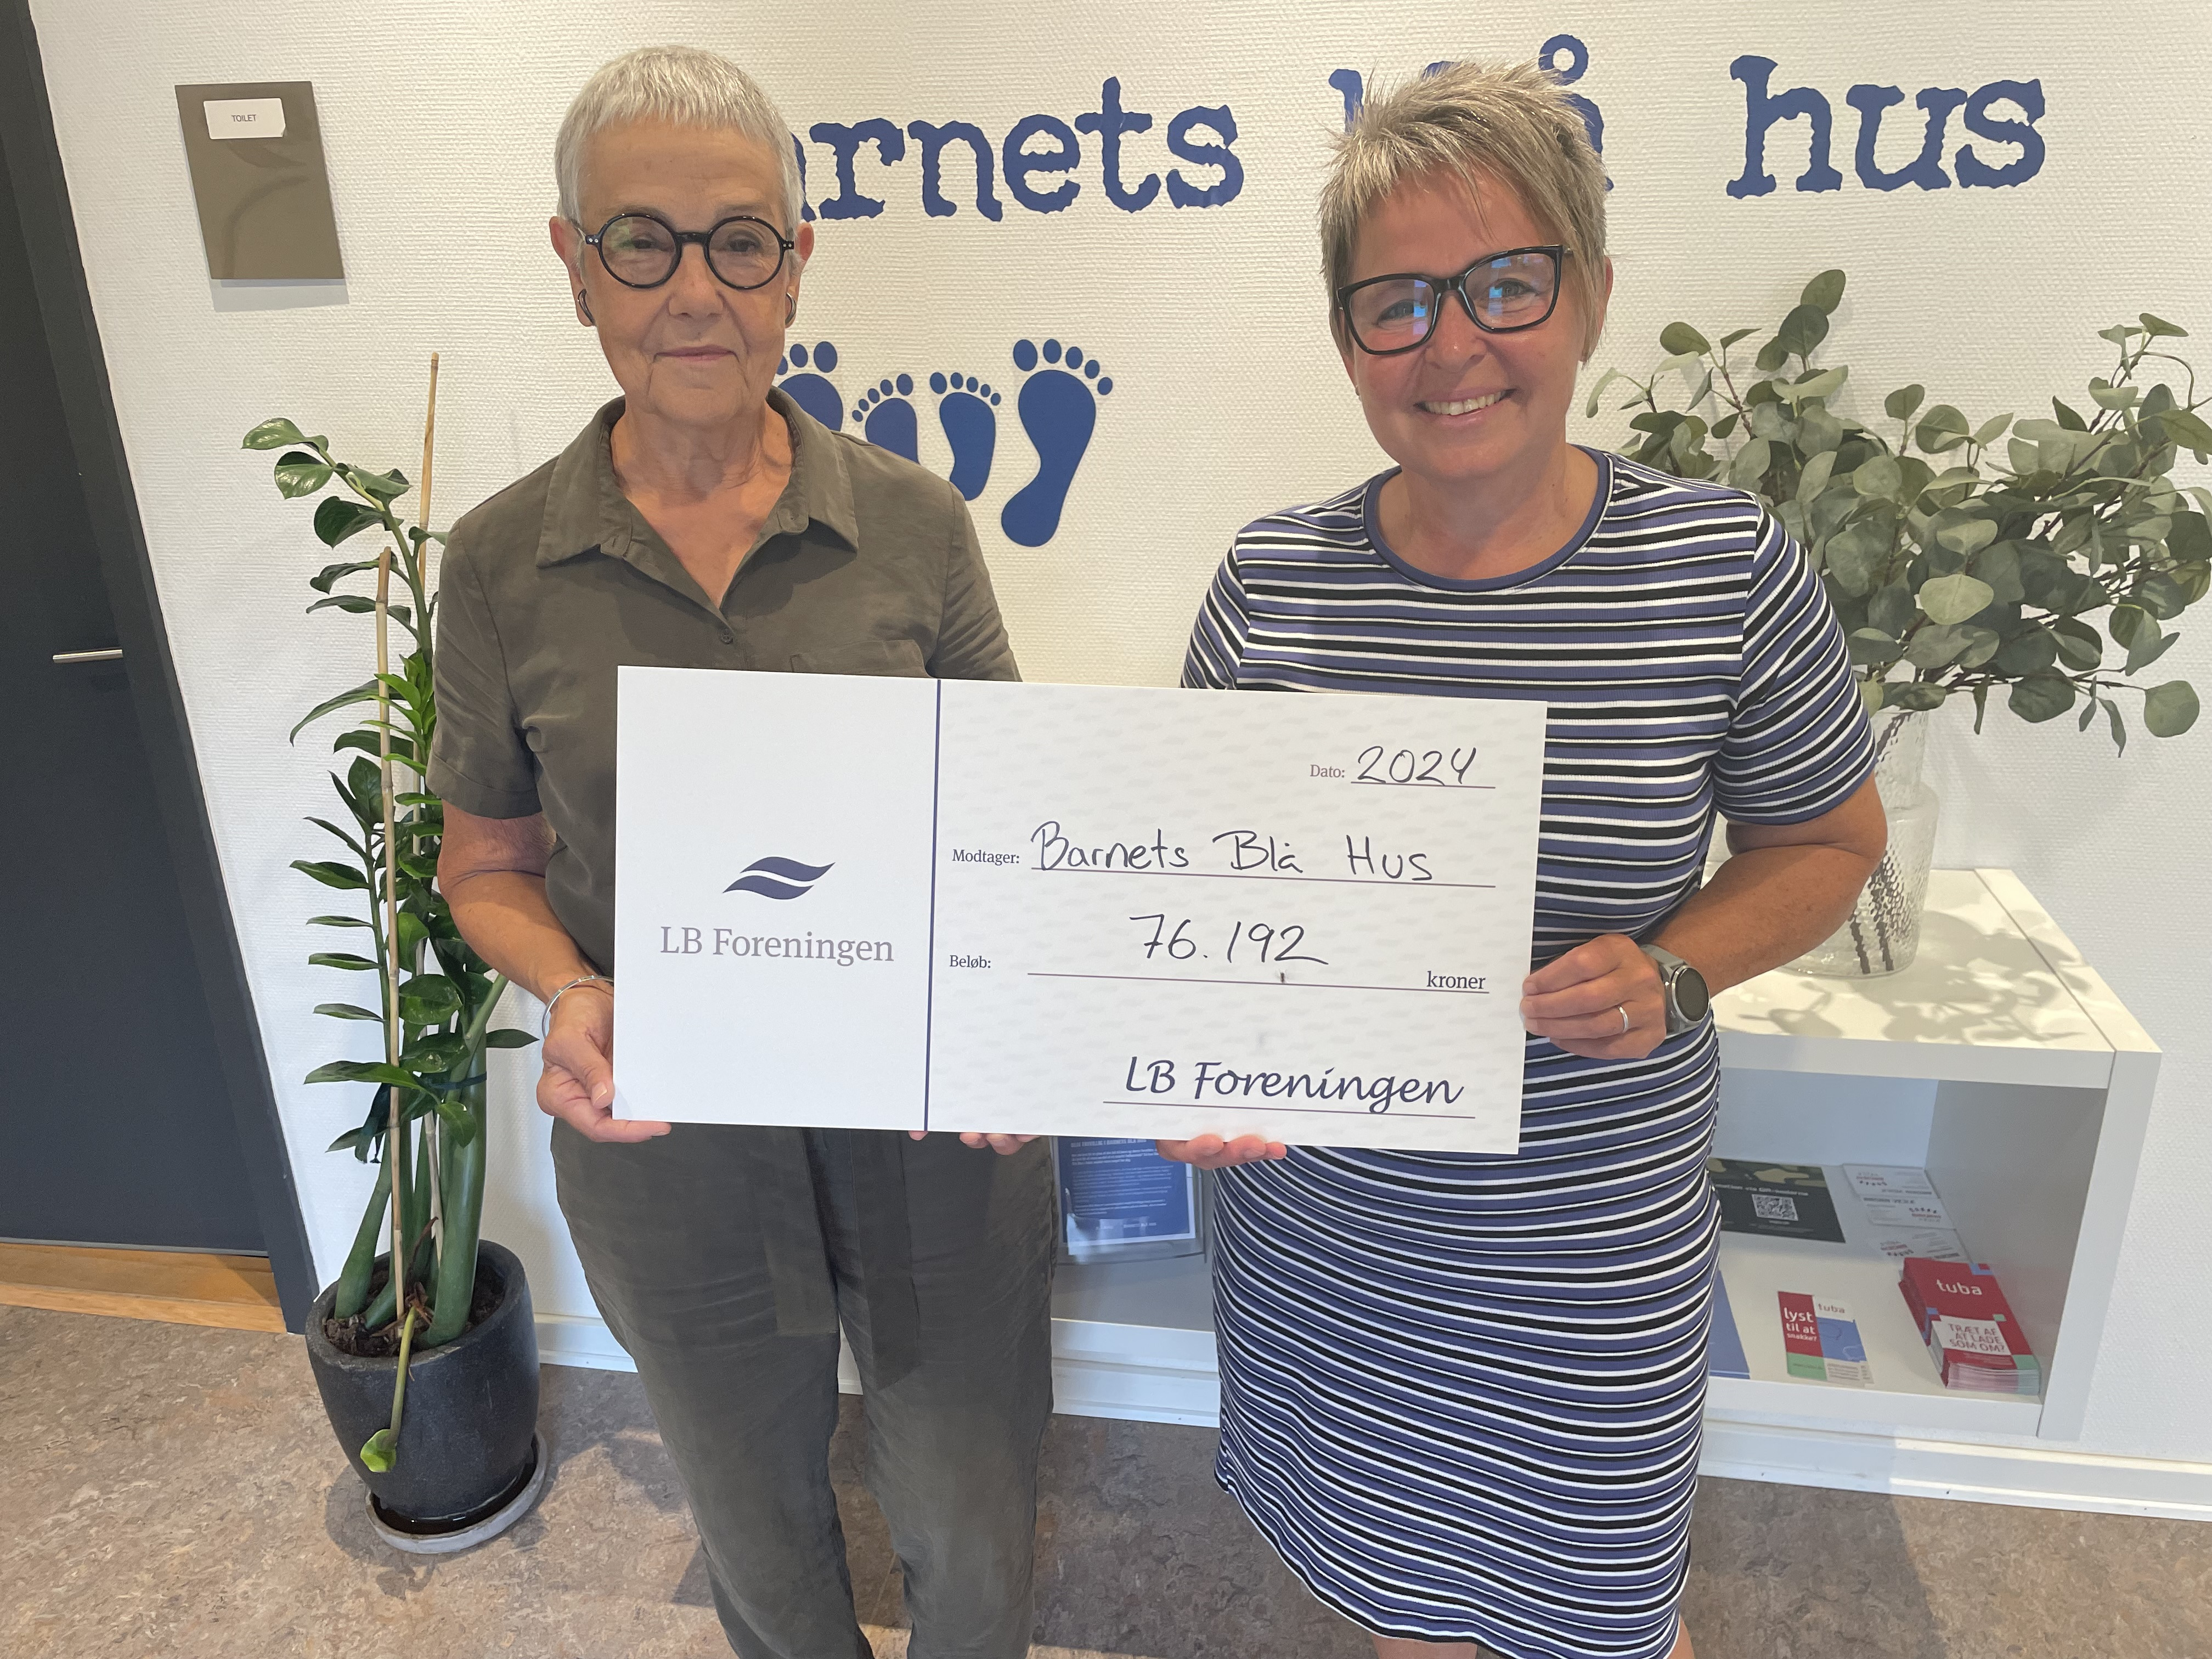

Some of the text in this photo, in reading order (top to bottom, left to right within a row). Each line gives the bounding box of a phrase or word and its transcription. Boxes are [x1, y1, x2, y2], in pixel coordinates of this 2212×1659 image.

[1726, 55, 2046, 199] hus
[1310, 745, 1477, 786] Dato: 2024
[952, 848, 1020, 866] Modtager:
[1030, 820, 1189, 871] Barnets
[1346, 834, 1432, 881] Hus
[660, 926, 895, 967] LB Foreningen
[949, 955, 991, 969] Beløb:
[1426, 970, 1487, 990] kroner
[1125, 1056, 1464, 1115] LB Foreningen
[1936, 1279, 1983, 1295] tuba
[1784, 1307, 1814, 1323] lyst
[1818, 1303, 1846, 1313] tuba
[1786, 1323, 1816, 1335] til at
[1948, 1323, 1981, 1335] TRÆT
[1949, 1339, 1977, 1350] SOM
